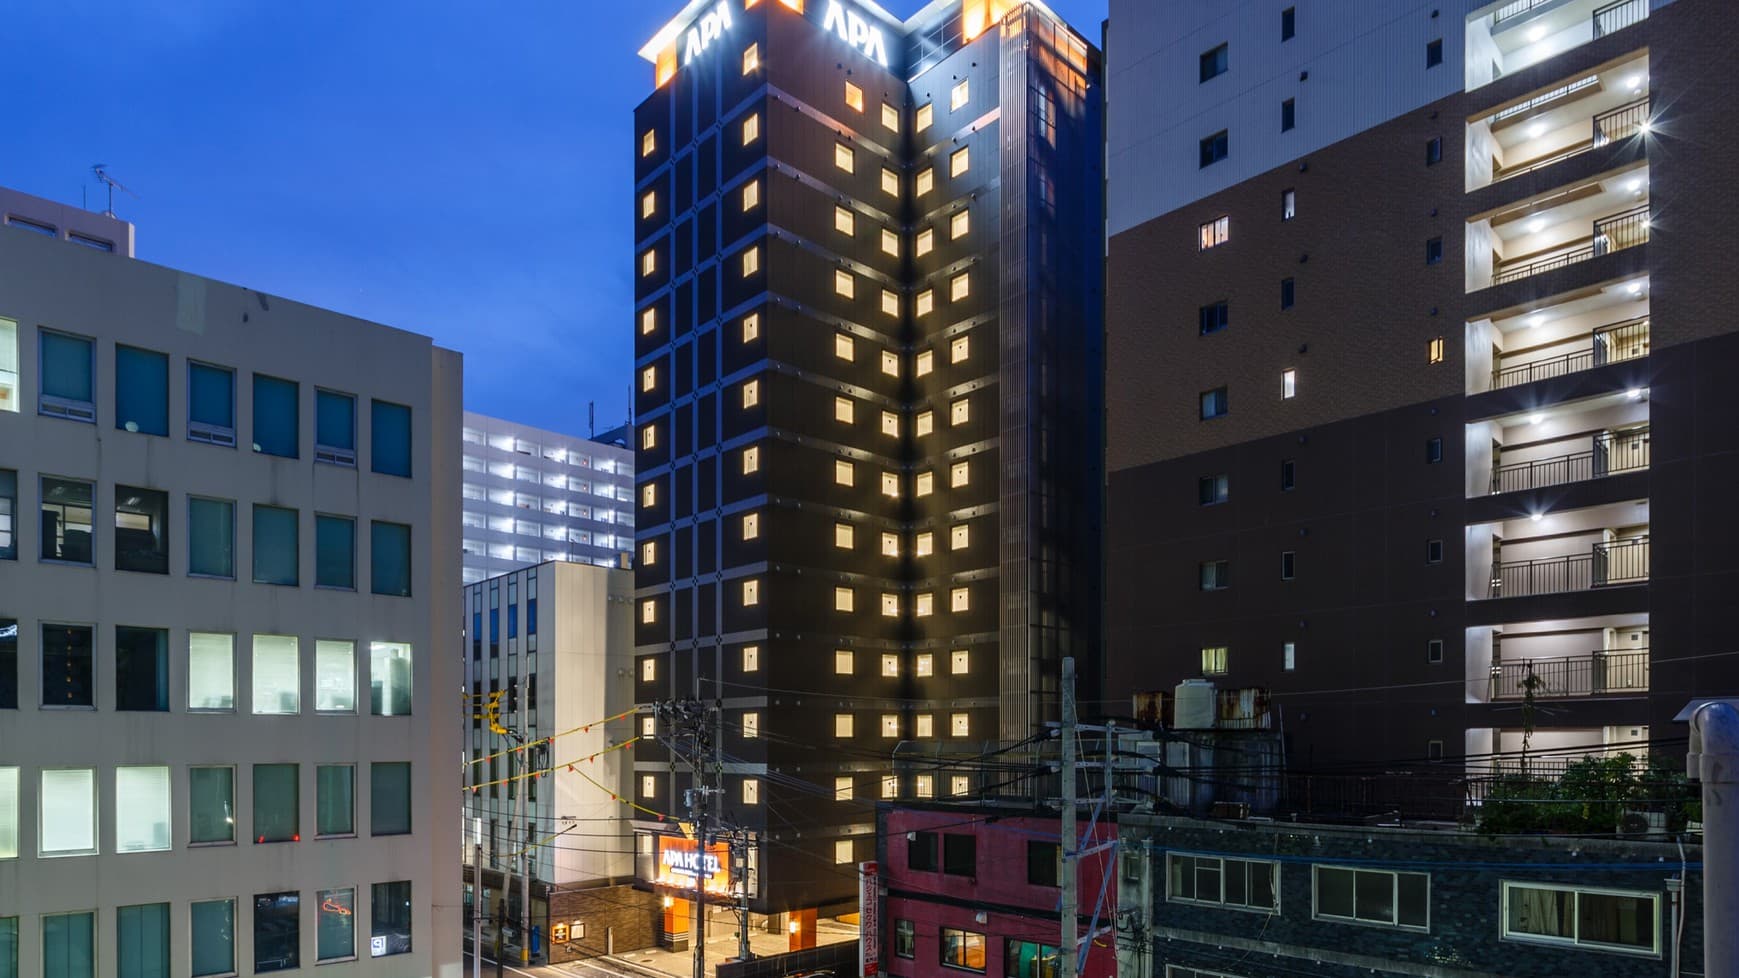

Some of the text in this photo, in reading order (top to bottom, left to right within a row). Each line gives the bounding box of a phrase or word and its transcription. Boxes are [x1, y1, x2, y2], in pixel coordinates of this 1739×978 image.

[684, 0, 732, 65] APA
[824, 1, 888, 67] APA
[663, 850, 684, 868] APA
